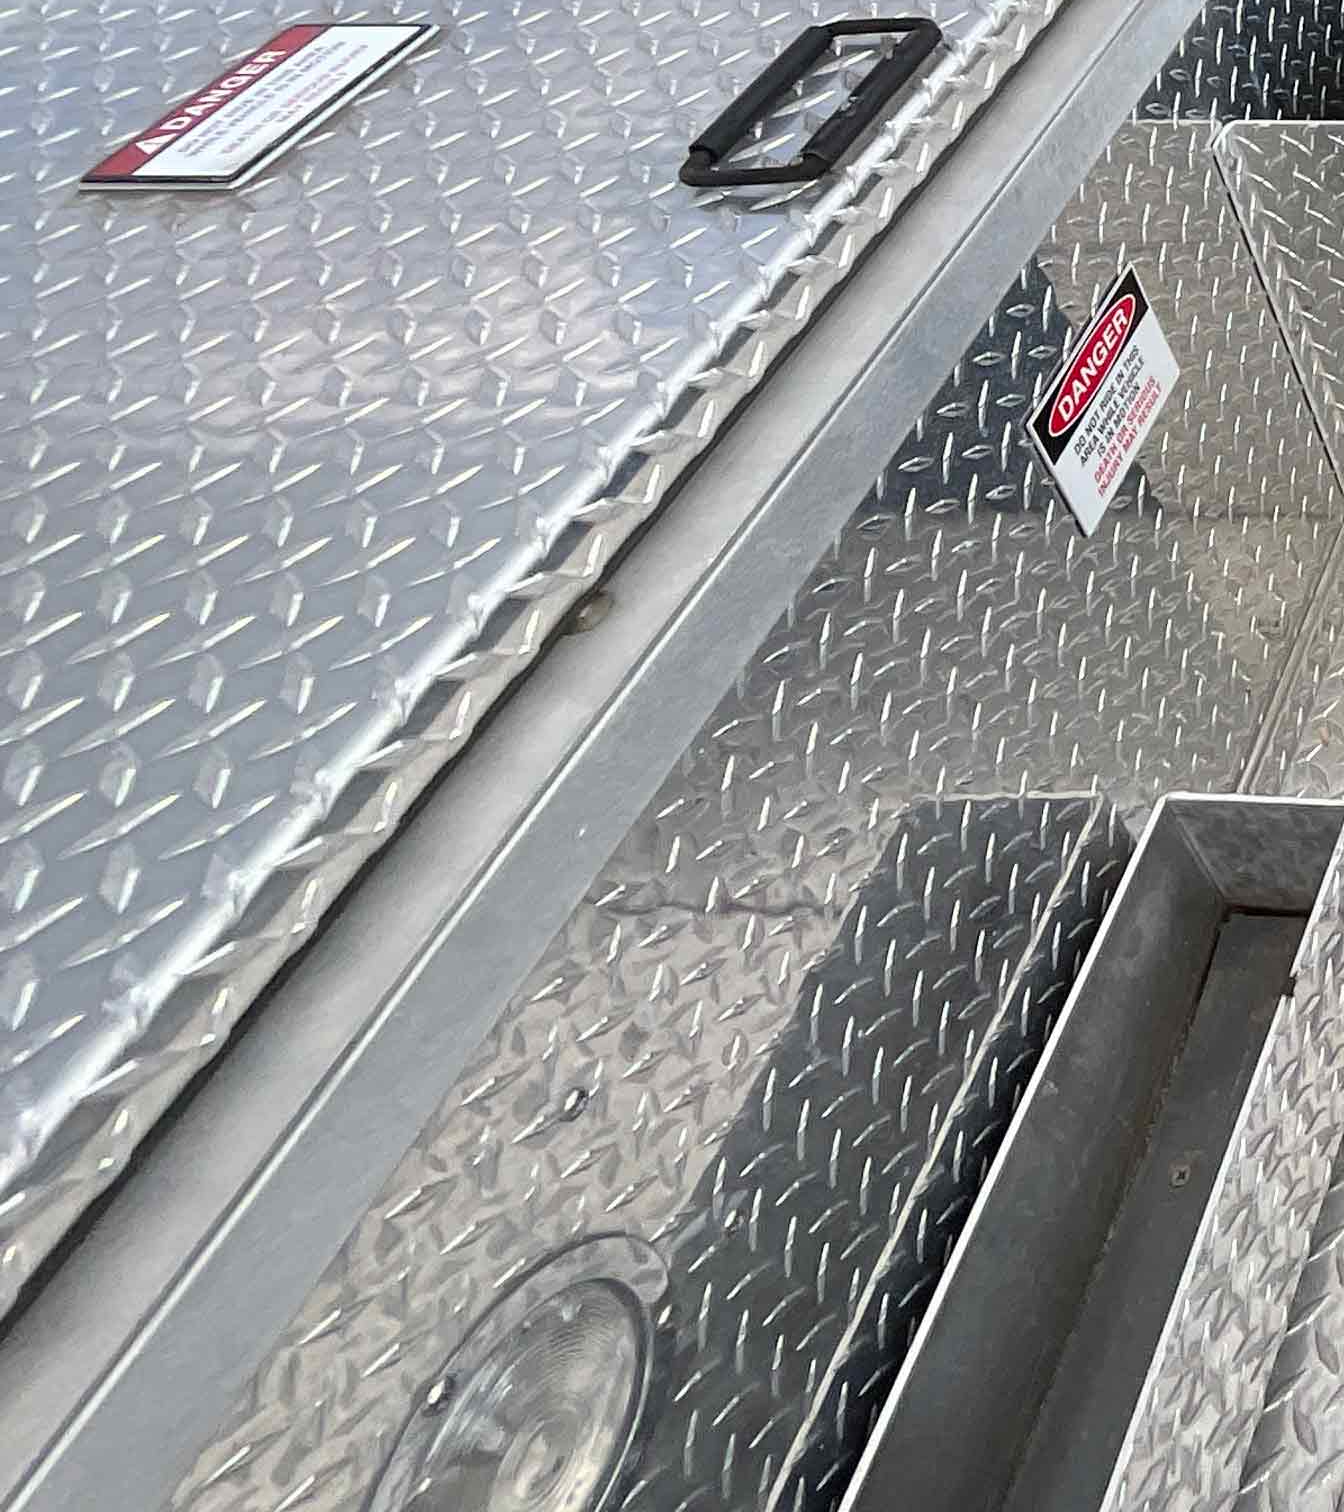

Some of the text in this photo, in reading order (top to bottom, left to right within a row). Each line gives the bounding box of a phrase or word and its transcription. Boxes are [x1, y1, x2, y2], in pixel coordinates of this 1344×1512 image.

[163, 48, 288, 130] DANGER
[1056, 307, 1128, 422] DANGER
[1074, 345, 1139, 455] DO NOT RIDE IN THIS
[1081, 355, 1144, 465] AREA WHILE VEHICLE
[1094, 376, 1155, 484] DEATH OR SERIOUS
[1097, 381, 1140, 457] IS IN MOTION
[1097, 454, 1123, 497] INJURY
[1122, 425, 1138, 454] MAY
